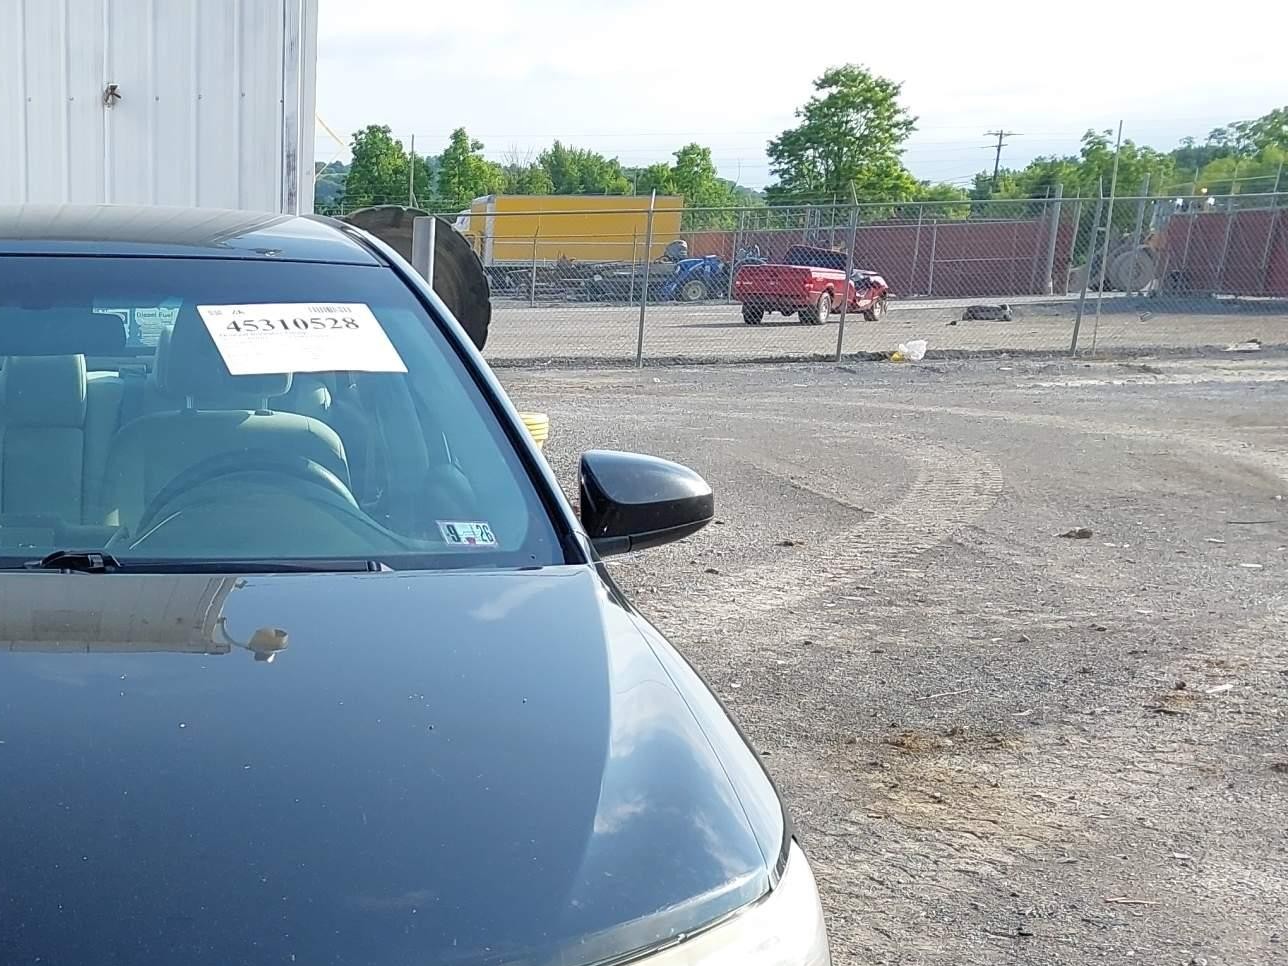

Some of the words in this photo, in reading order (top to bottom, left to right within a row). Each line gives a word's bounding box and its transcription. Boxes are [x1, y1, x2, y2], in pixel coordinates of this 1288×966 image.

[226, 317, 360, 332] 45310528
[446, 524, 461, 542] 9
[475, 524, 494, 542] 26
